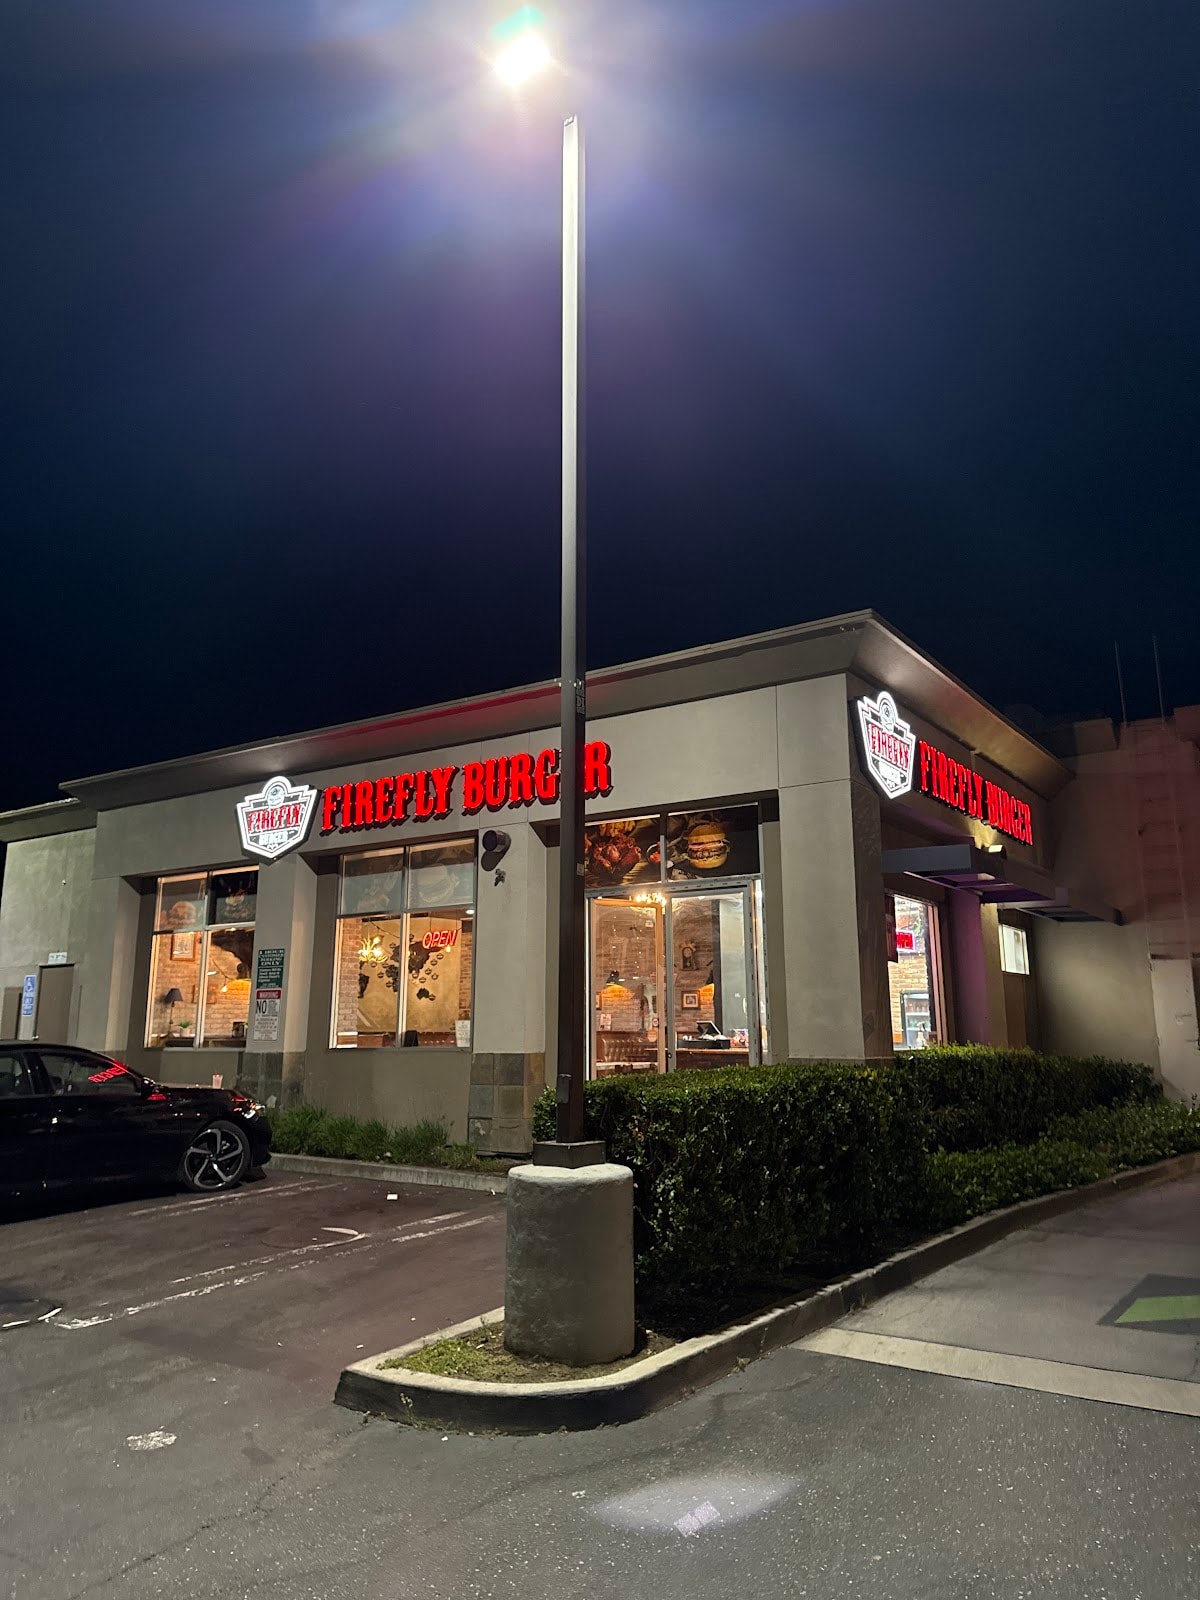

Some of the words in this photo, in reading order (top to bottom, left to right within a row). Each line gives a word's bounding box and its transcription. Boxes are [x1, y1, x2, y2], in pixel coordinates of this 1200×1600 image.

[321, 765, 456, 831] FIREFLY
[463, 741, 610, 809] BURGR
[919, 740, 983, 820] FIREFLY
[985, 780, 1033, 846] BURGER
[247, 804, 302, 833] FIREFLY
[422, 930, 457, 949] OPEN
[256, 1000, 267, 1014] NO
